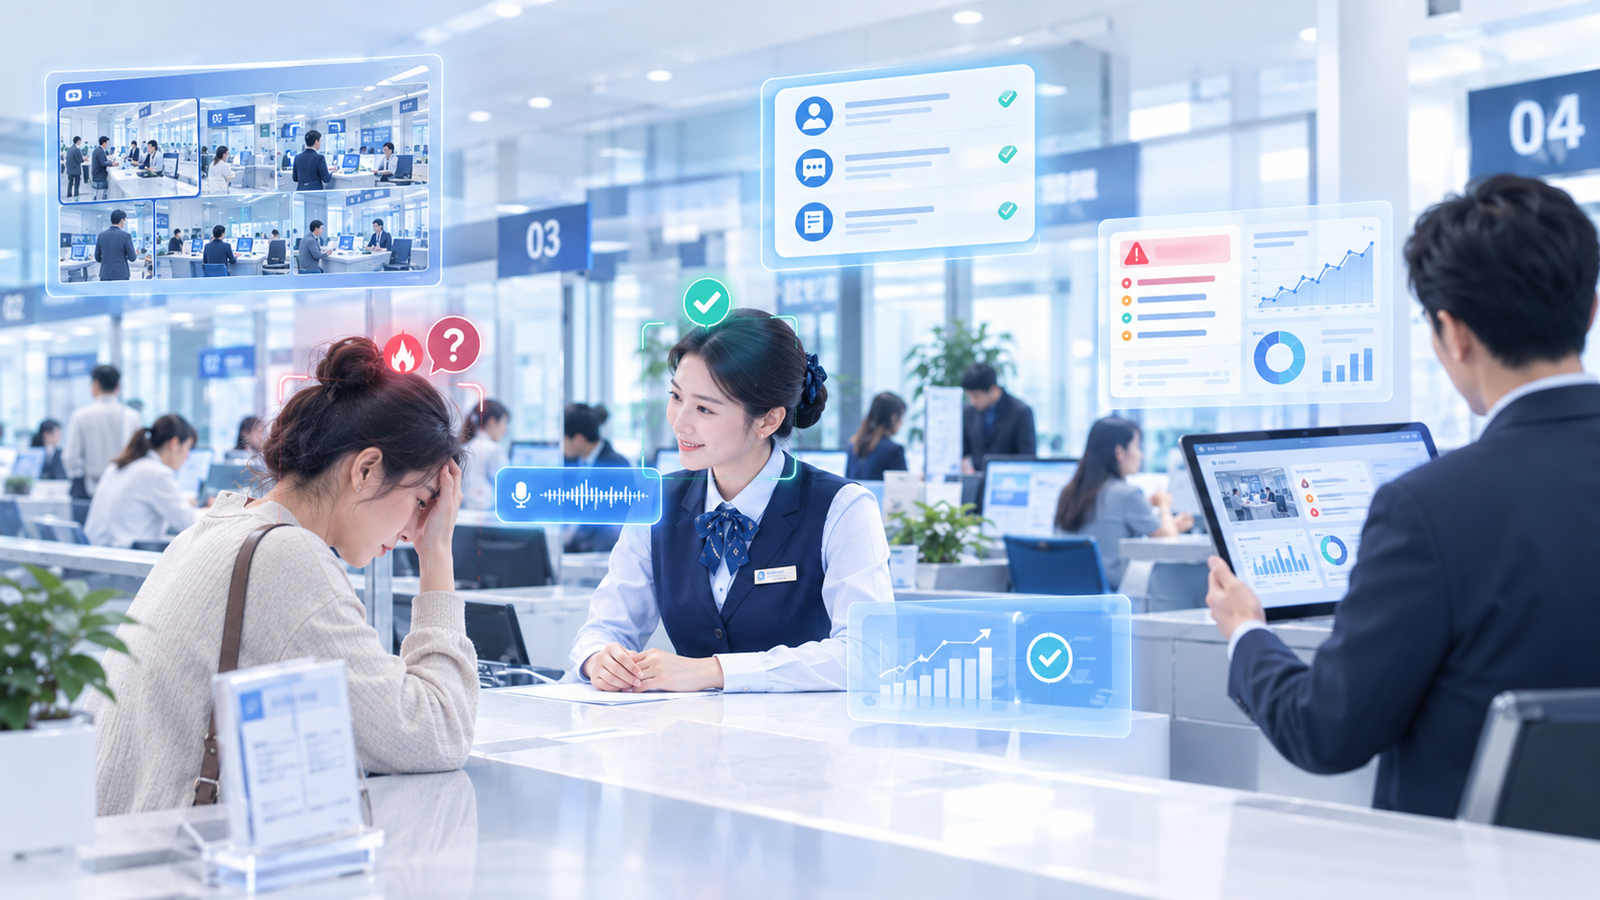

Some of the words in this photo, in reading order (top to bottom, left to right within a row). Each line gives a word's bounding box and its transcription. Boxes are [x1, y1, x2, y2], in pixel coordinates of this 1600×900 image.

[1509, 93, 1585, 156] 04
[526, 219, 561, 260] 03
[2, 294, 25, 321] 02
